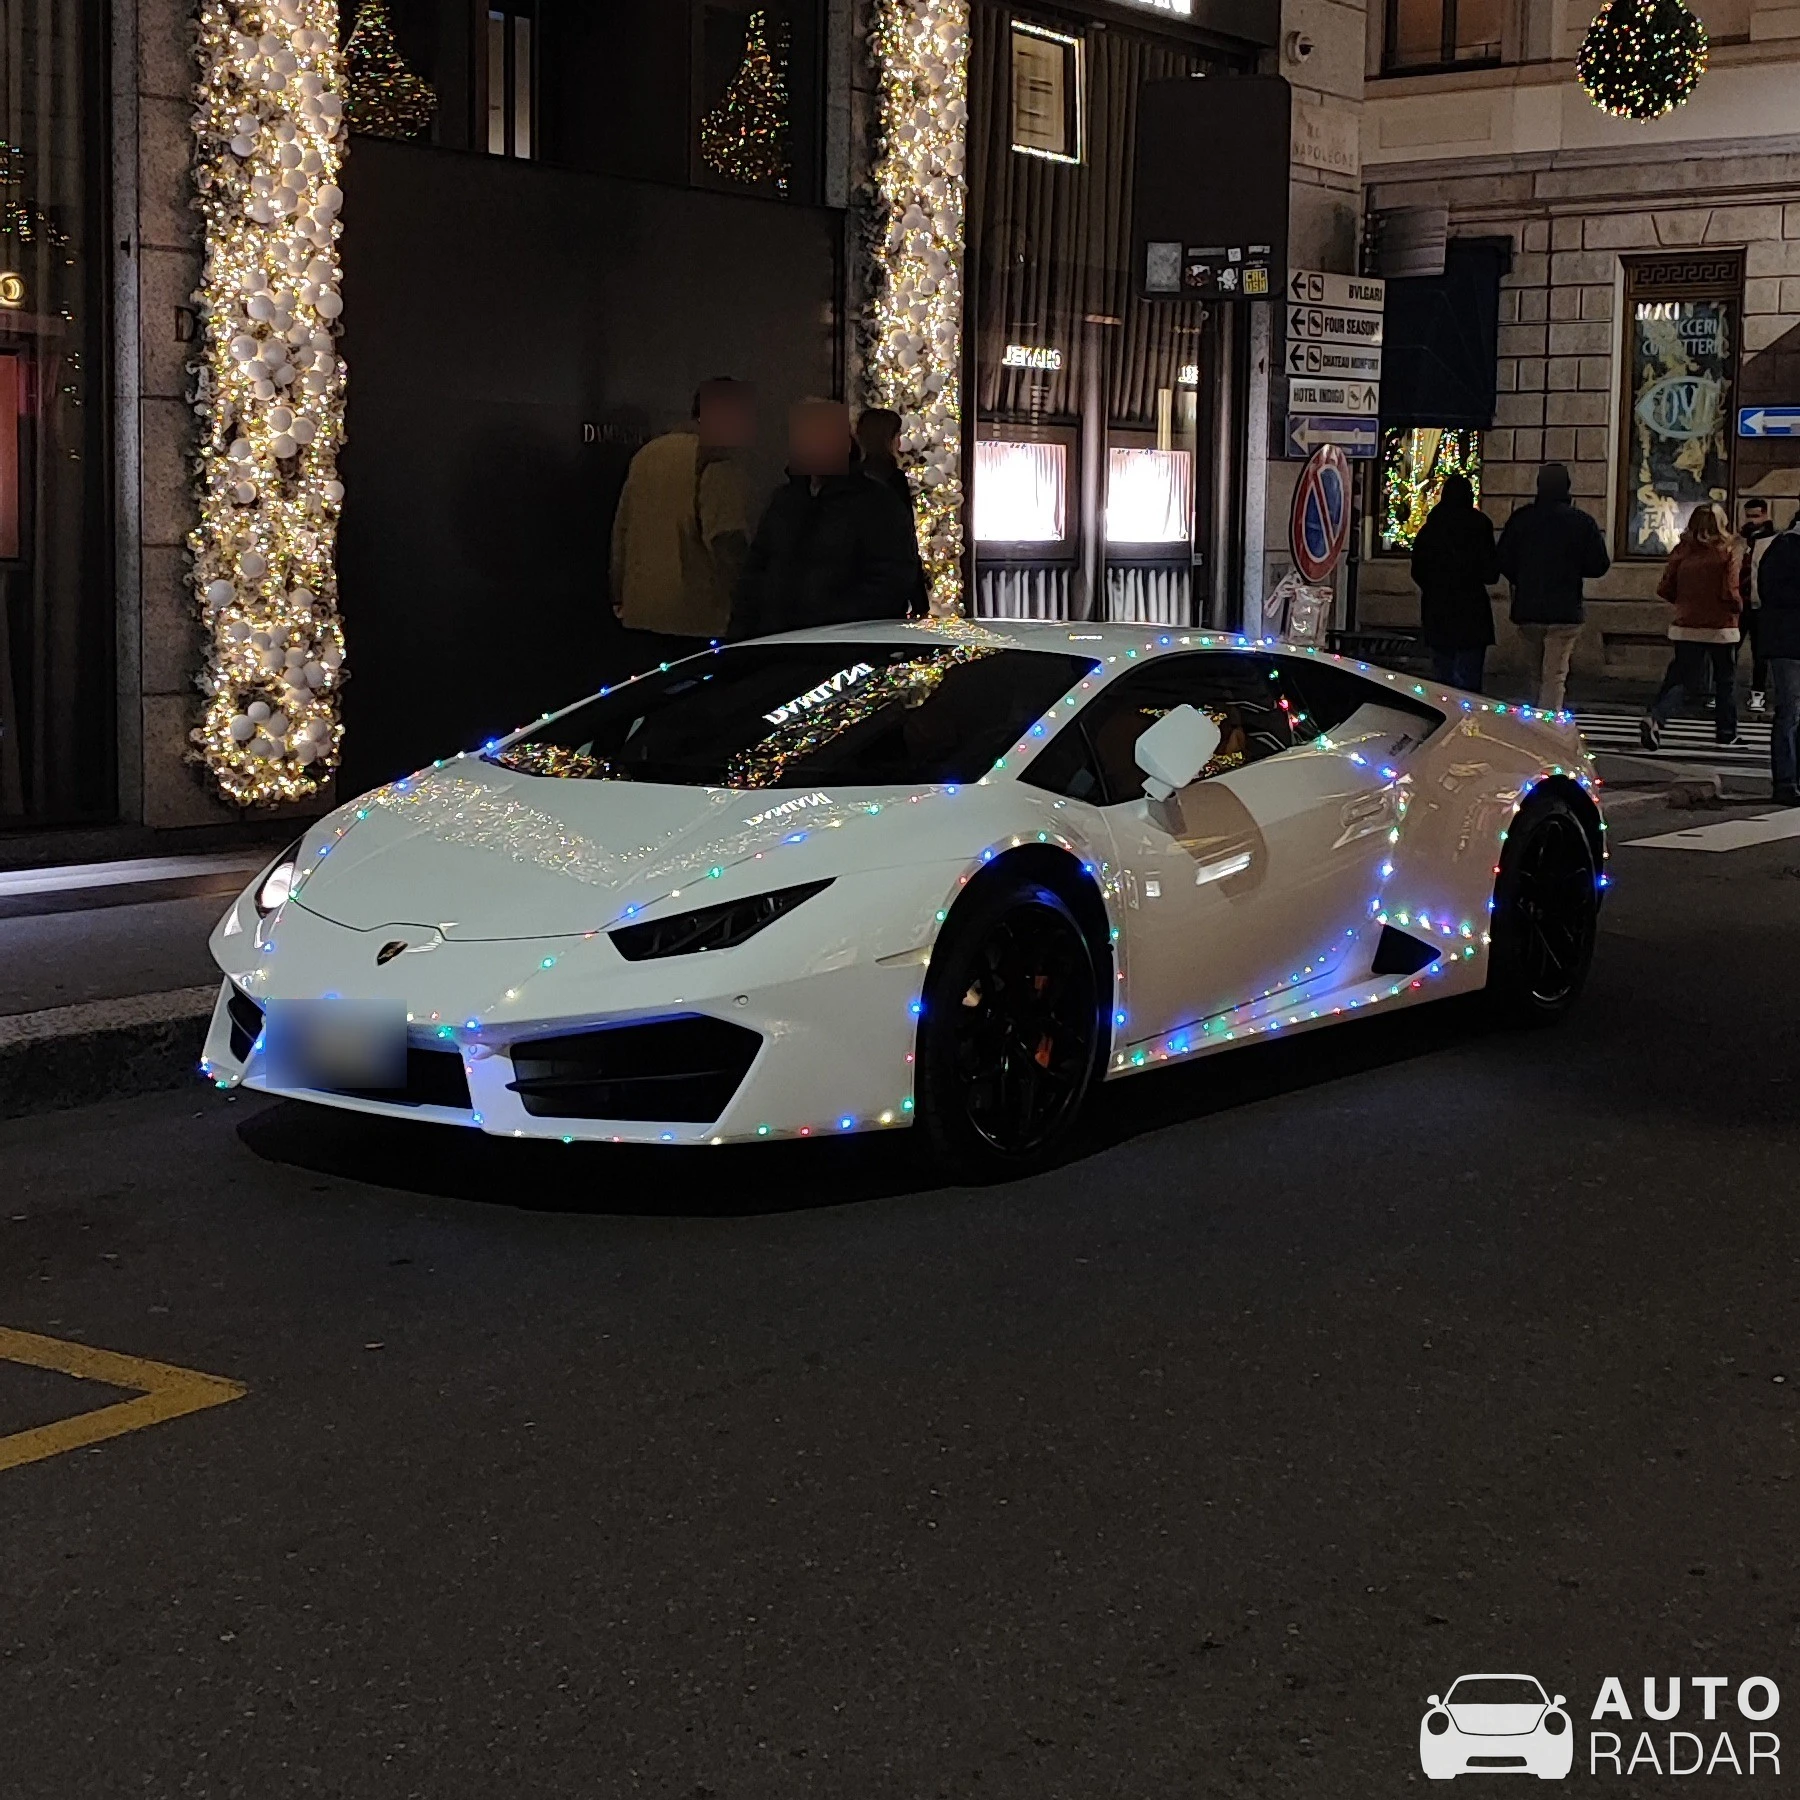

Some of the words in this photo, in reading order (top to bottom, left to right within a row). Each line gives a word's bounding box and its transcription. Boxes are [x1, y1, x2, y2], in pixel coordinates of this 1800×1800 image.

[1348, 284, 1383, 302] BVLGARI
[1324, 316, 1345, 334] FOUR
[1293, 387, 1318, 403] HOTEL
[1319, 388, 1345, 404] INDIGO
